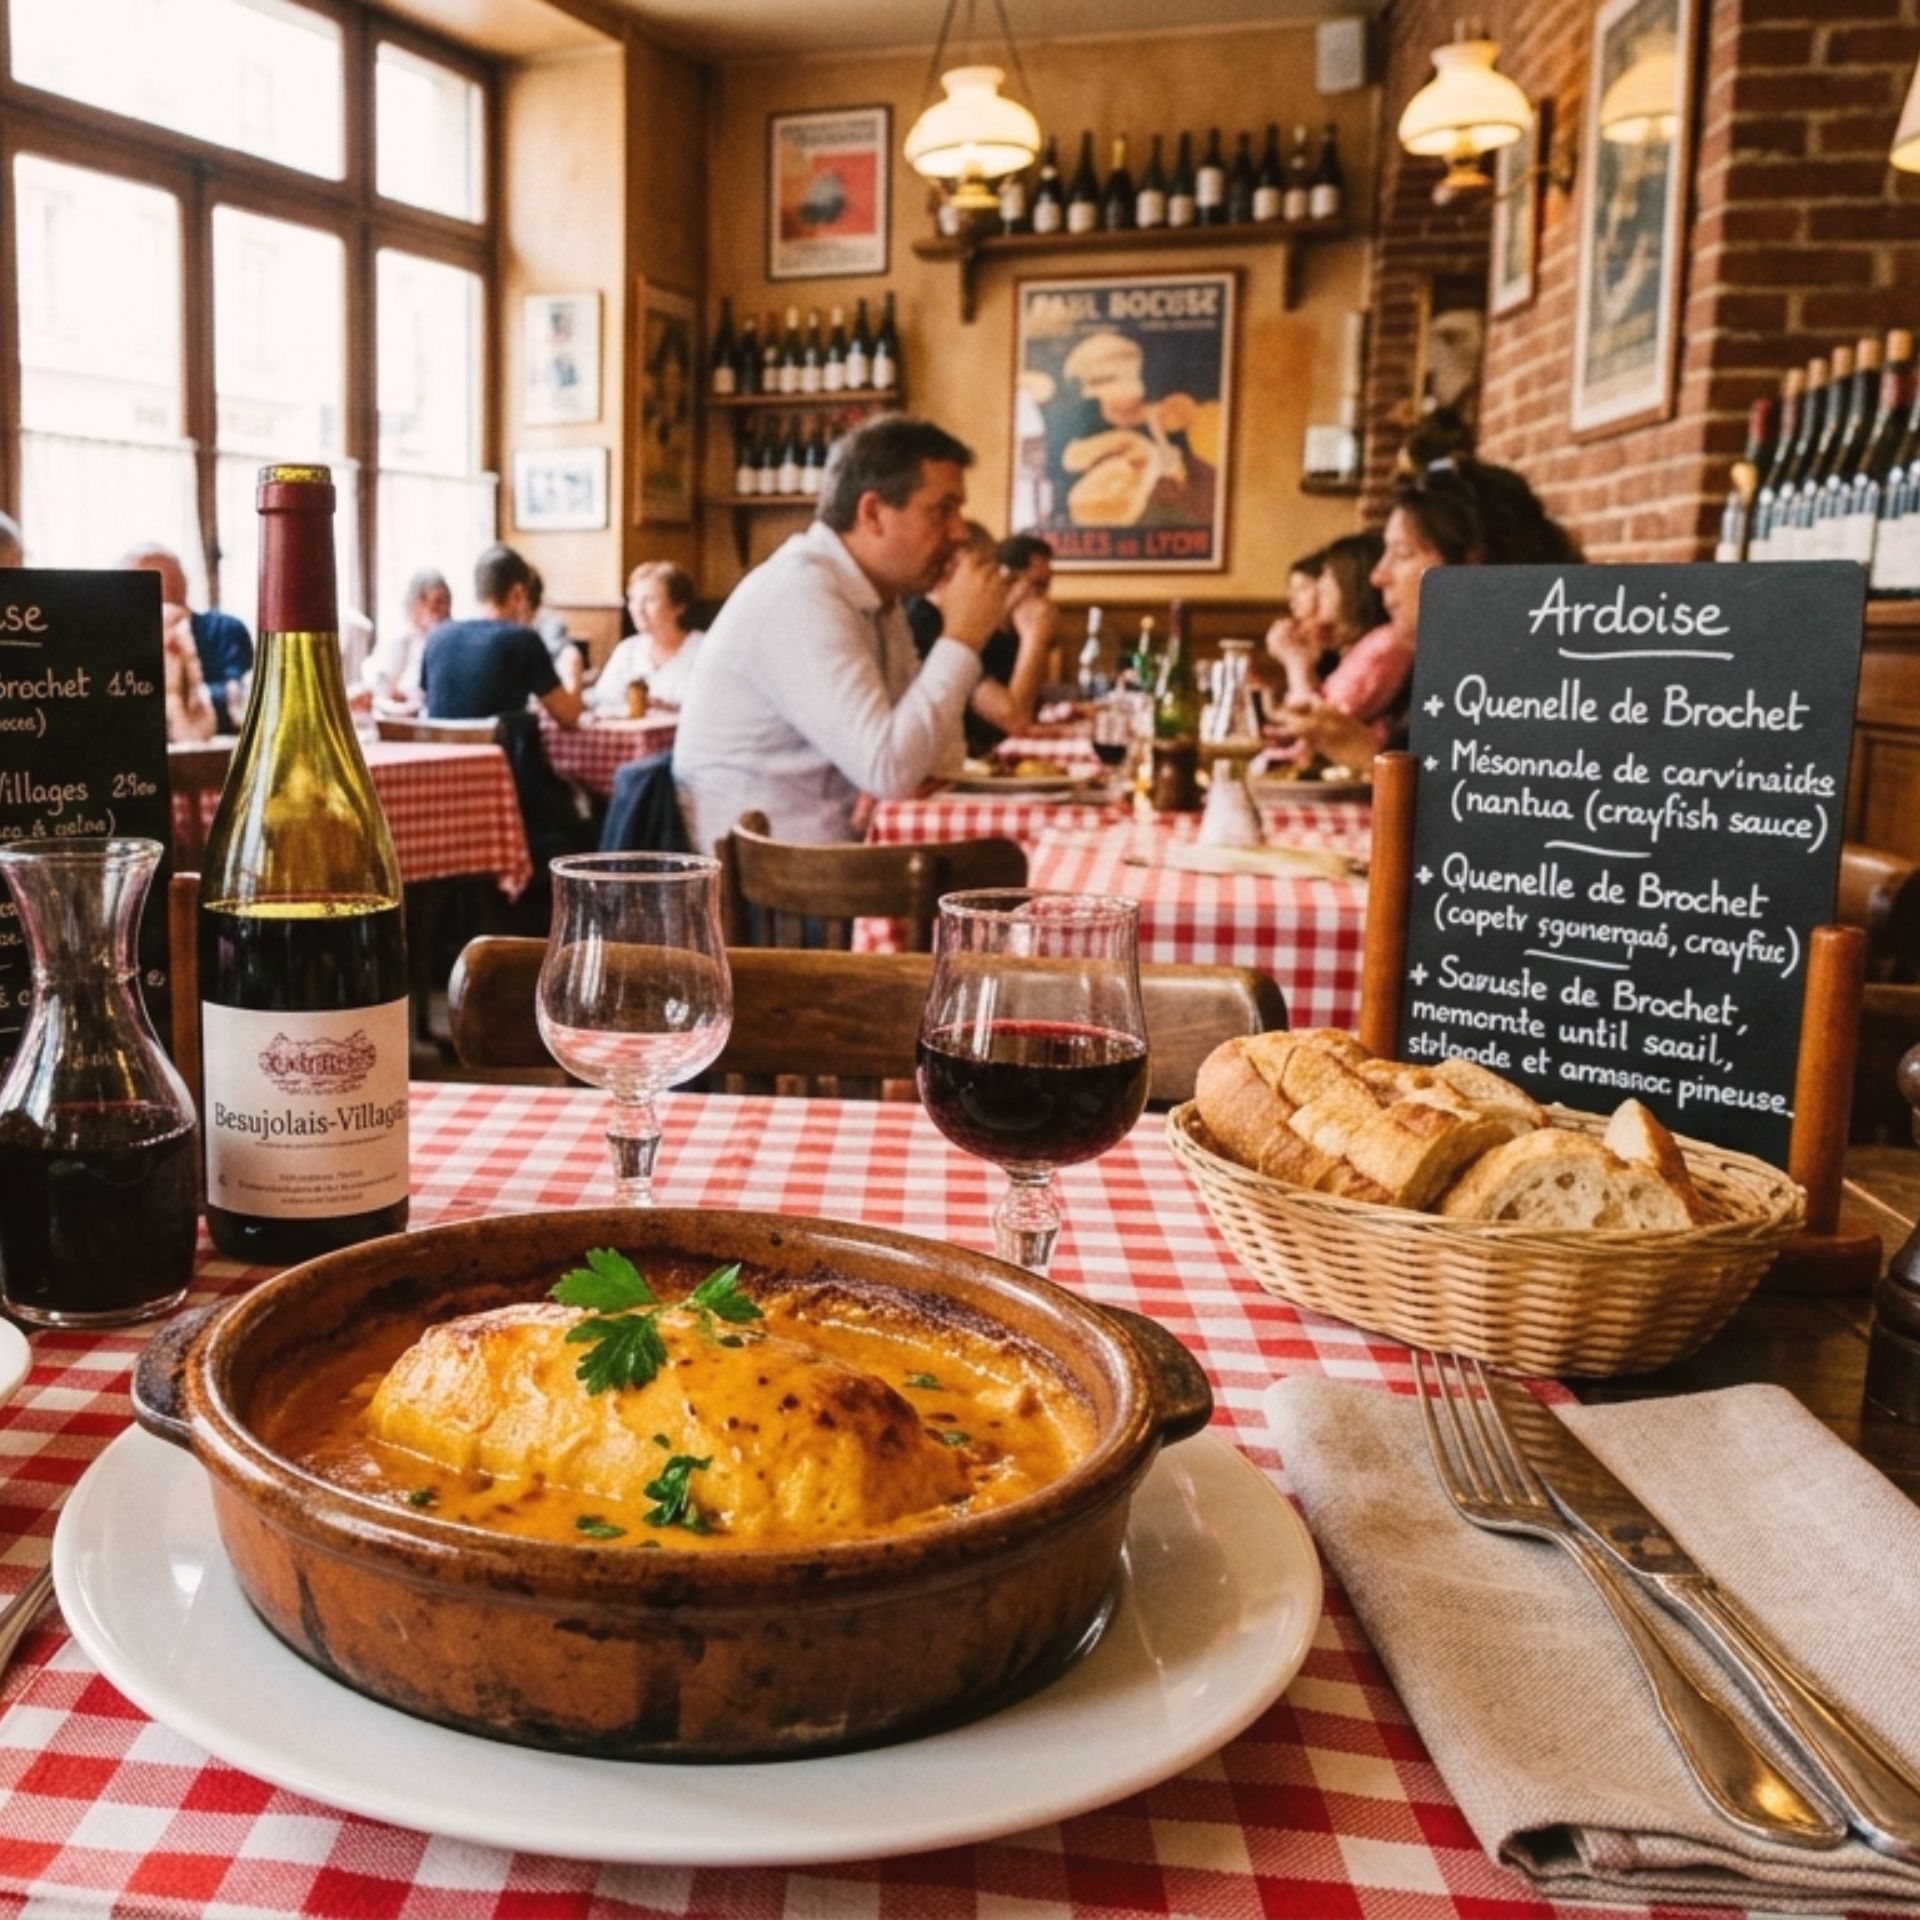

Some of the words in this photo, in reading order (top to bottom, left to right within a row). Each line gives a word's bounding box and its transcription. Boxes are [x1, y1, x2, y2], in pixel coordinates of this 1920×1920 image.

[0, 604, 48, 632] se
[1529, 577, 1730, 636] Ardoise
[1453, 674, 1598, 725] Quenelle
[1609, 687, 1649, 724] de
[1662, 684, 1810, 731] Brochet
[1613, 753, 1650, 784] de
[1450, 779, 1574, 823] (nantua
[1584, 790, 1720, 843] (crayfish
[1728, 804, 1828, 854] sauce)
[1441, 852, 1576, 899] Quenelle
[1587, 869, 1626, 904] de
[1638, 872, 1770, 918] Brochet
[1560, 976, 1600, 1007] de
[1613, 980, 1748, 1036] Brochet,
[1558, 1018, 1629, 1050] until
[1521, 1047, 1552, 1075] et
[214, 1098, 409, 1141] Besujolais-Villag
